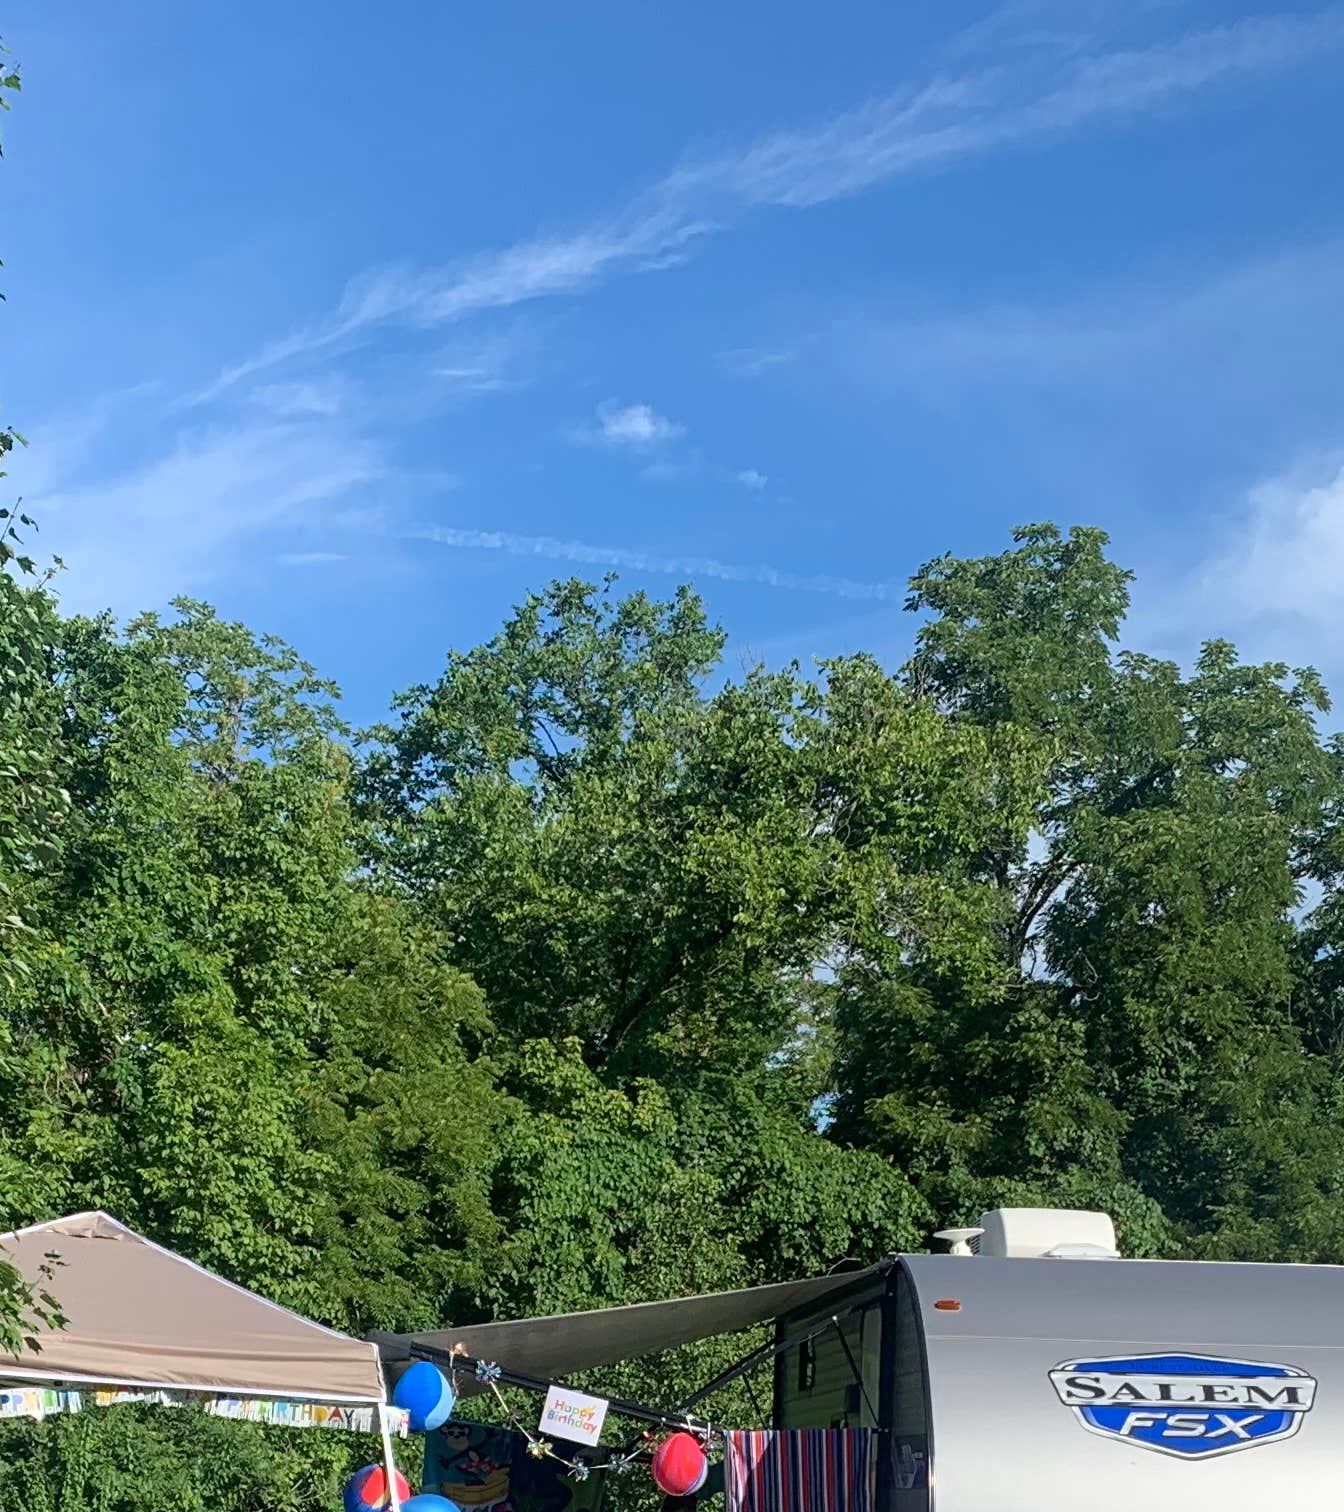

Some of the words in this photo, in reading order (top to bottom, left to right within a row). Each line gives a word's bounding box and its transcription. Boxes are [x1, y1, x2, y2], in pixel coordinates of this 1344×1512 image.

[1065, 1376, 1306, 1405] SALEM
[547, 1410, 598, 1435] Birthday
[554, 1400, 596, 1421] Happy
[1119, 1412, 1265, 1439] FSX
